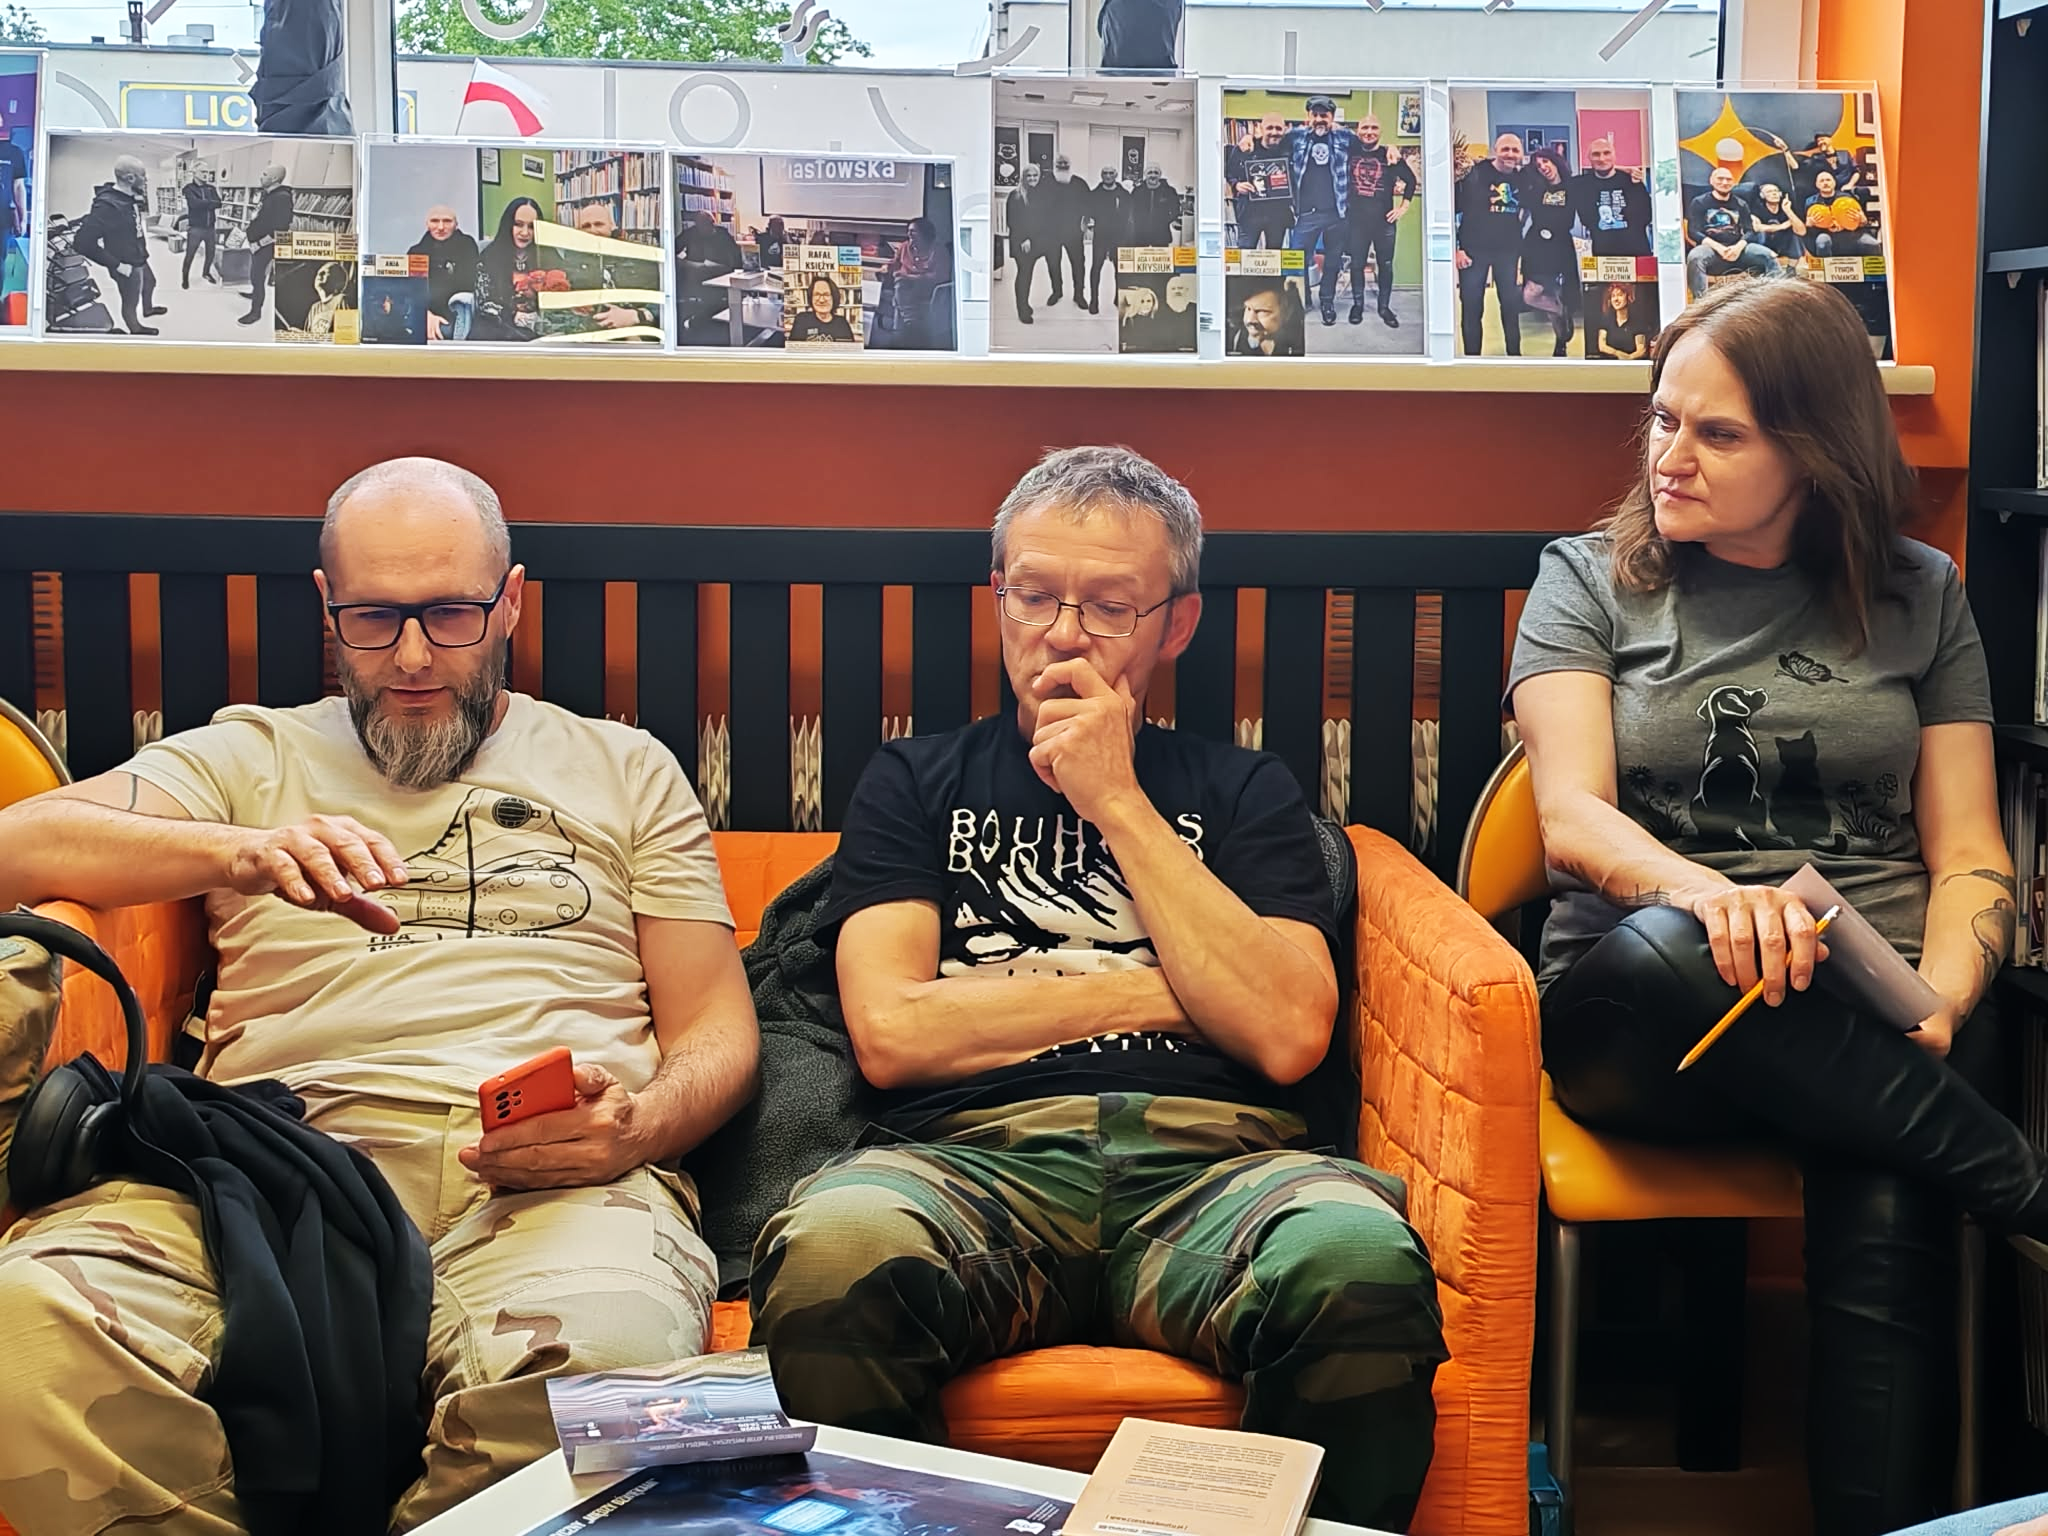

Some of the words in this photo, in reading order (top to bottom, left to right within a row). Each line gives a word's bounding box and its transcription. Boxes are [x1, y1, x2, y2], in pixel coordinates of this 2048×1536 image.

[295, 239, 332, 247] KRZYSZTOF
[294, 249, 334, 257] GRABOWSKI
[808, 251, 833, 260] RAFAŁ
[805, 260, 836, 271] KSIĘŻYK
[1136, 263, 1172, 273] KRYSIUK
[1604, 265, 1629, 273] SYLWIA
[947, 808, 1204, 882] BAUHS
